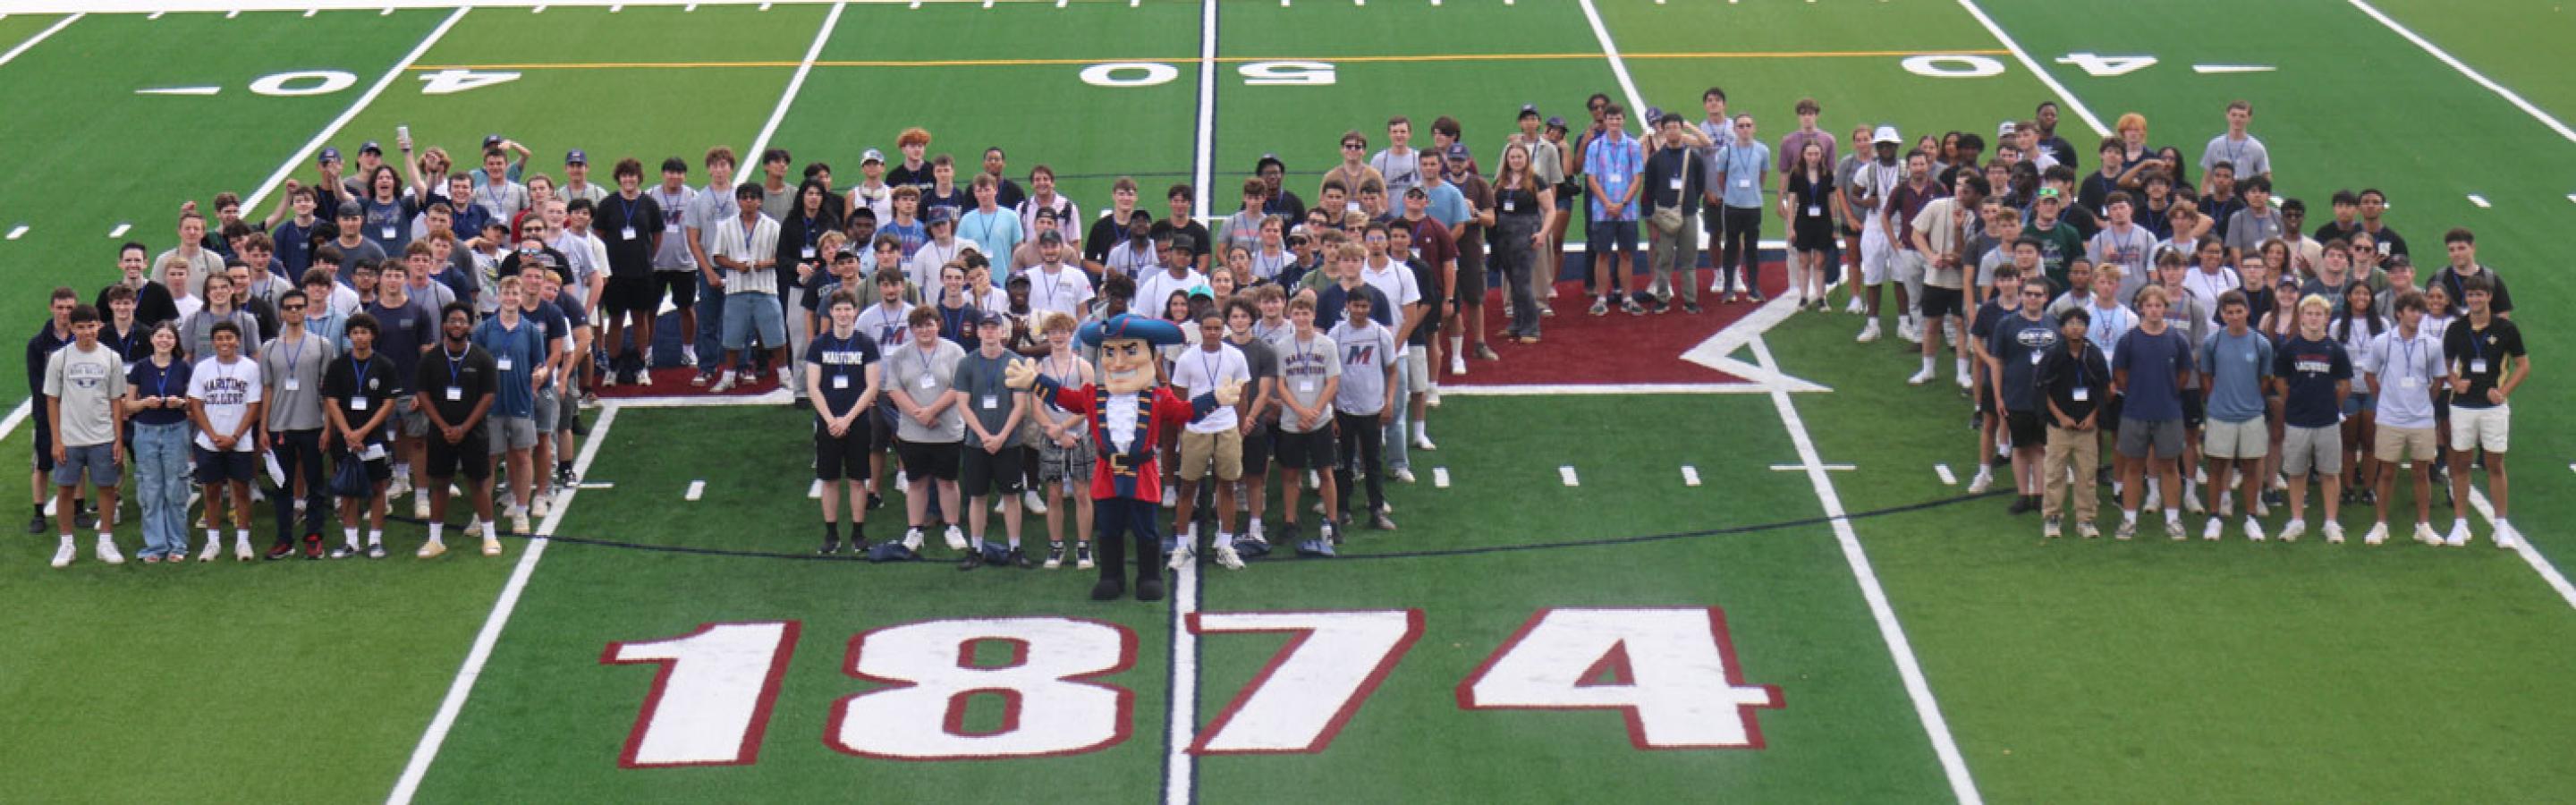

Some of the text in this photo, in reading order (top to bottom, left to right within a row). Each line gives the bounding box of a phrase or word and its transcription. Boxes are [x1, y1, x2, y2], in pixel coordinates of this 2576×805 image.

[1346, 345, 1374, 365] M
[204, 376, 248, 392] MARITIME
[601, 606, 1785, 767] 1874
